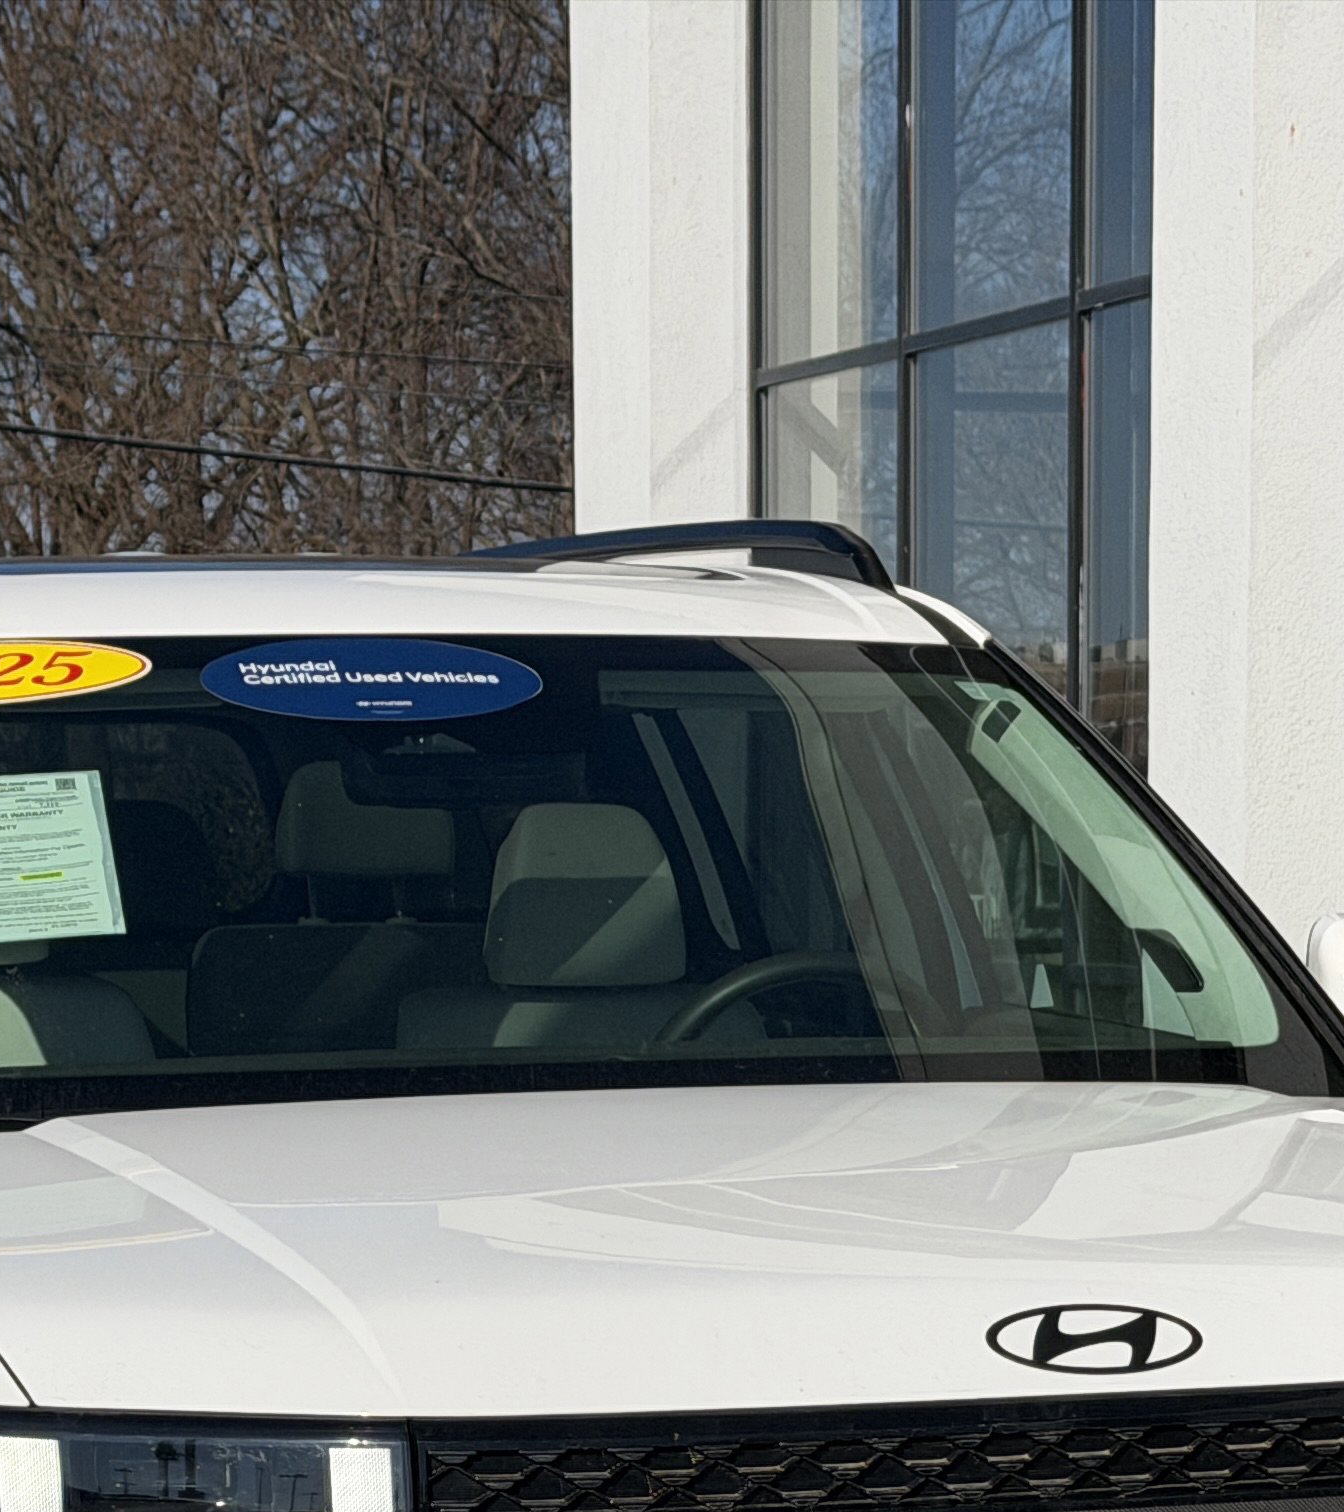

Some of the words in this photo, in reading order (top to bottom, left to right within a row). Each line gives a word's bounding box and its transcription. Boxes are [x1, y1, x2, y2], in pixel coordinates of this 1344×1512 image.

[238, 660, 337, 674] Hyundai
[243, 671, 341, 685] Certified
[345, 672, 403, 684] Used
[405, 671, 500, 684] Vehicles
[10, 809, 64, 818] WARRANTY
